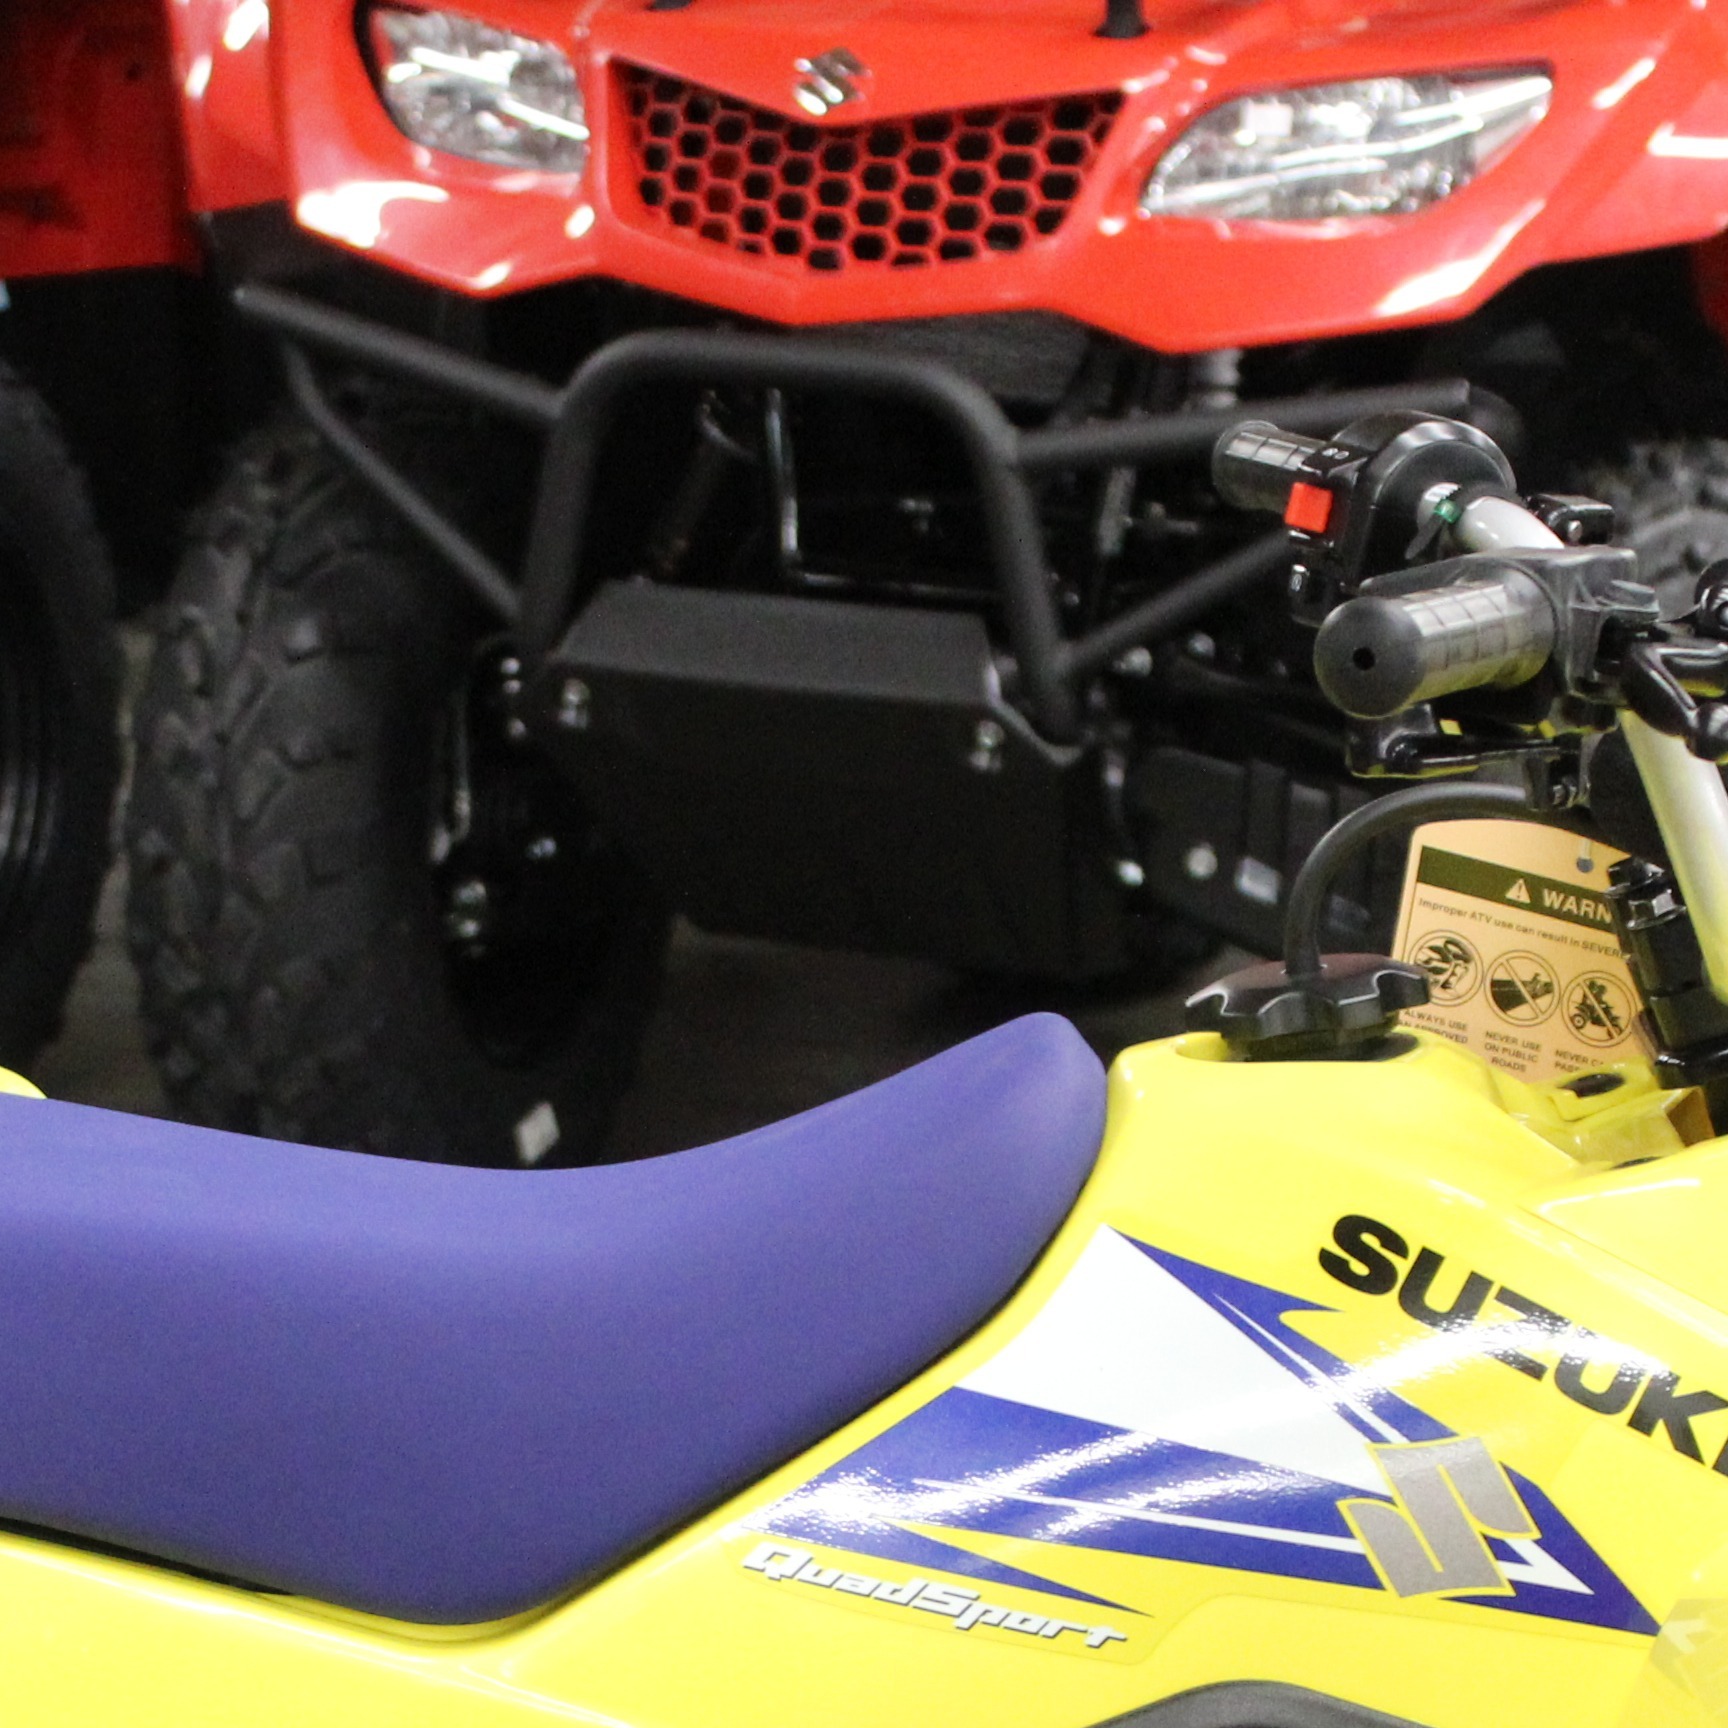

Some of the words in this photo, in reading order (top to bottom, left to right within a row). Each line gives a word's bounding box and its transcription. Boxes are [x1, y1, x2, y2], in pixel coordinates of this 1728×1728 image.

[1542, 888, 1613, 924] WARN
[1418, 897, 1468, 919] Improper
[1469, 910, 1493, 924] ATV
[1494, 918, 1514, 931] use
[1515, 922, 1535, 935] can
[1536, 927, 1568, 944] result
[1448, 1019, 1468, 1031] USE
[1485, 1030, 1518, 1046] NEVER
[1522, 1040, 1542, 1052] USE
[1484, 1042, 1501, 1053] ON
[1502, 1047, 1538, 1063] PUBLIC
[1554, 1049, 1588, 1065] NEVER
[1491, 1056, 1527, 1073] ROADS
[742, 1542, 1128, 1648] QuadSport
